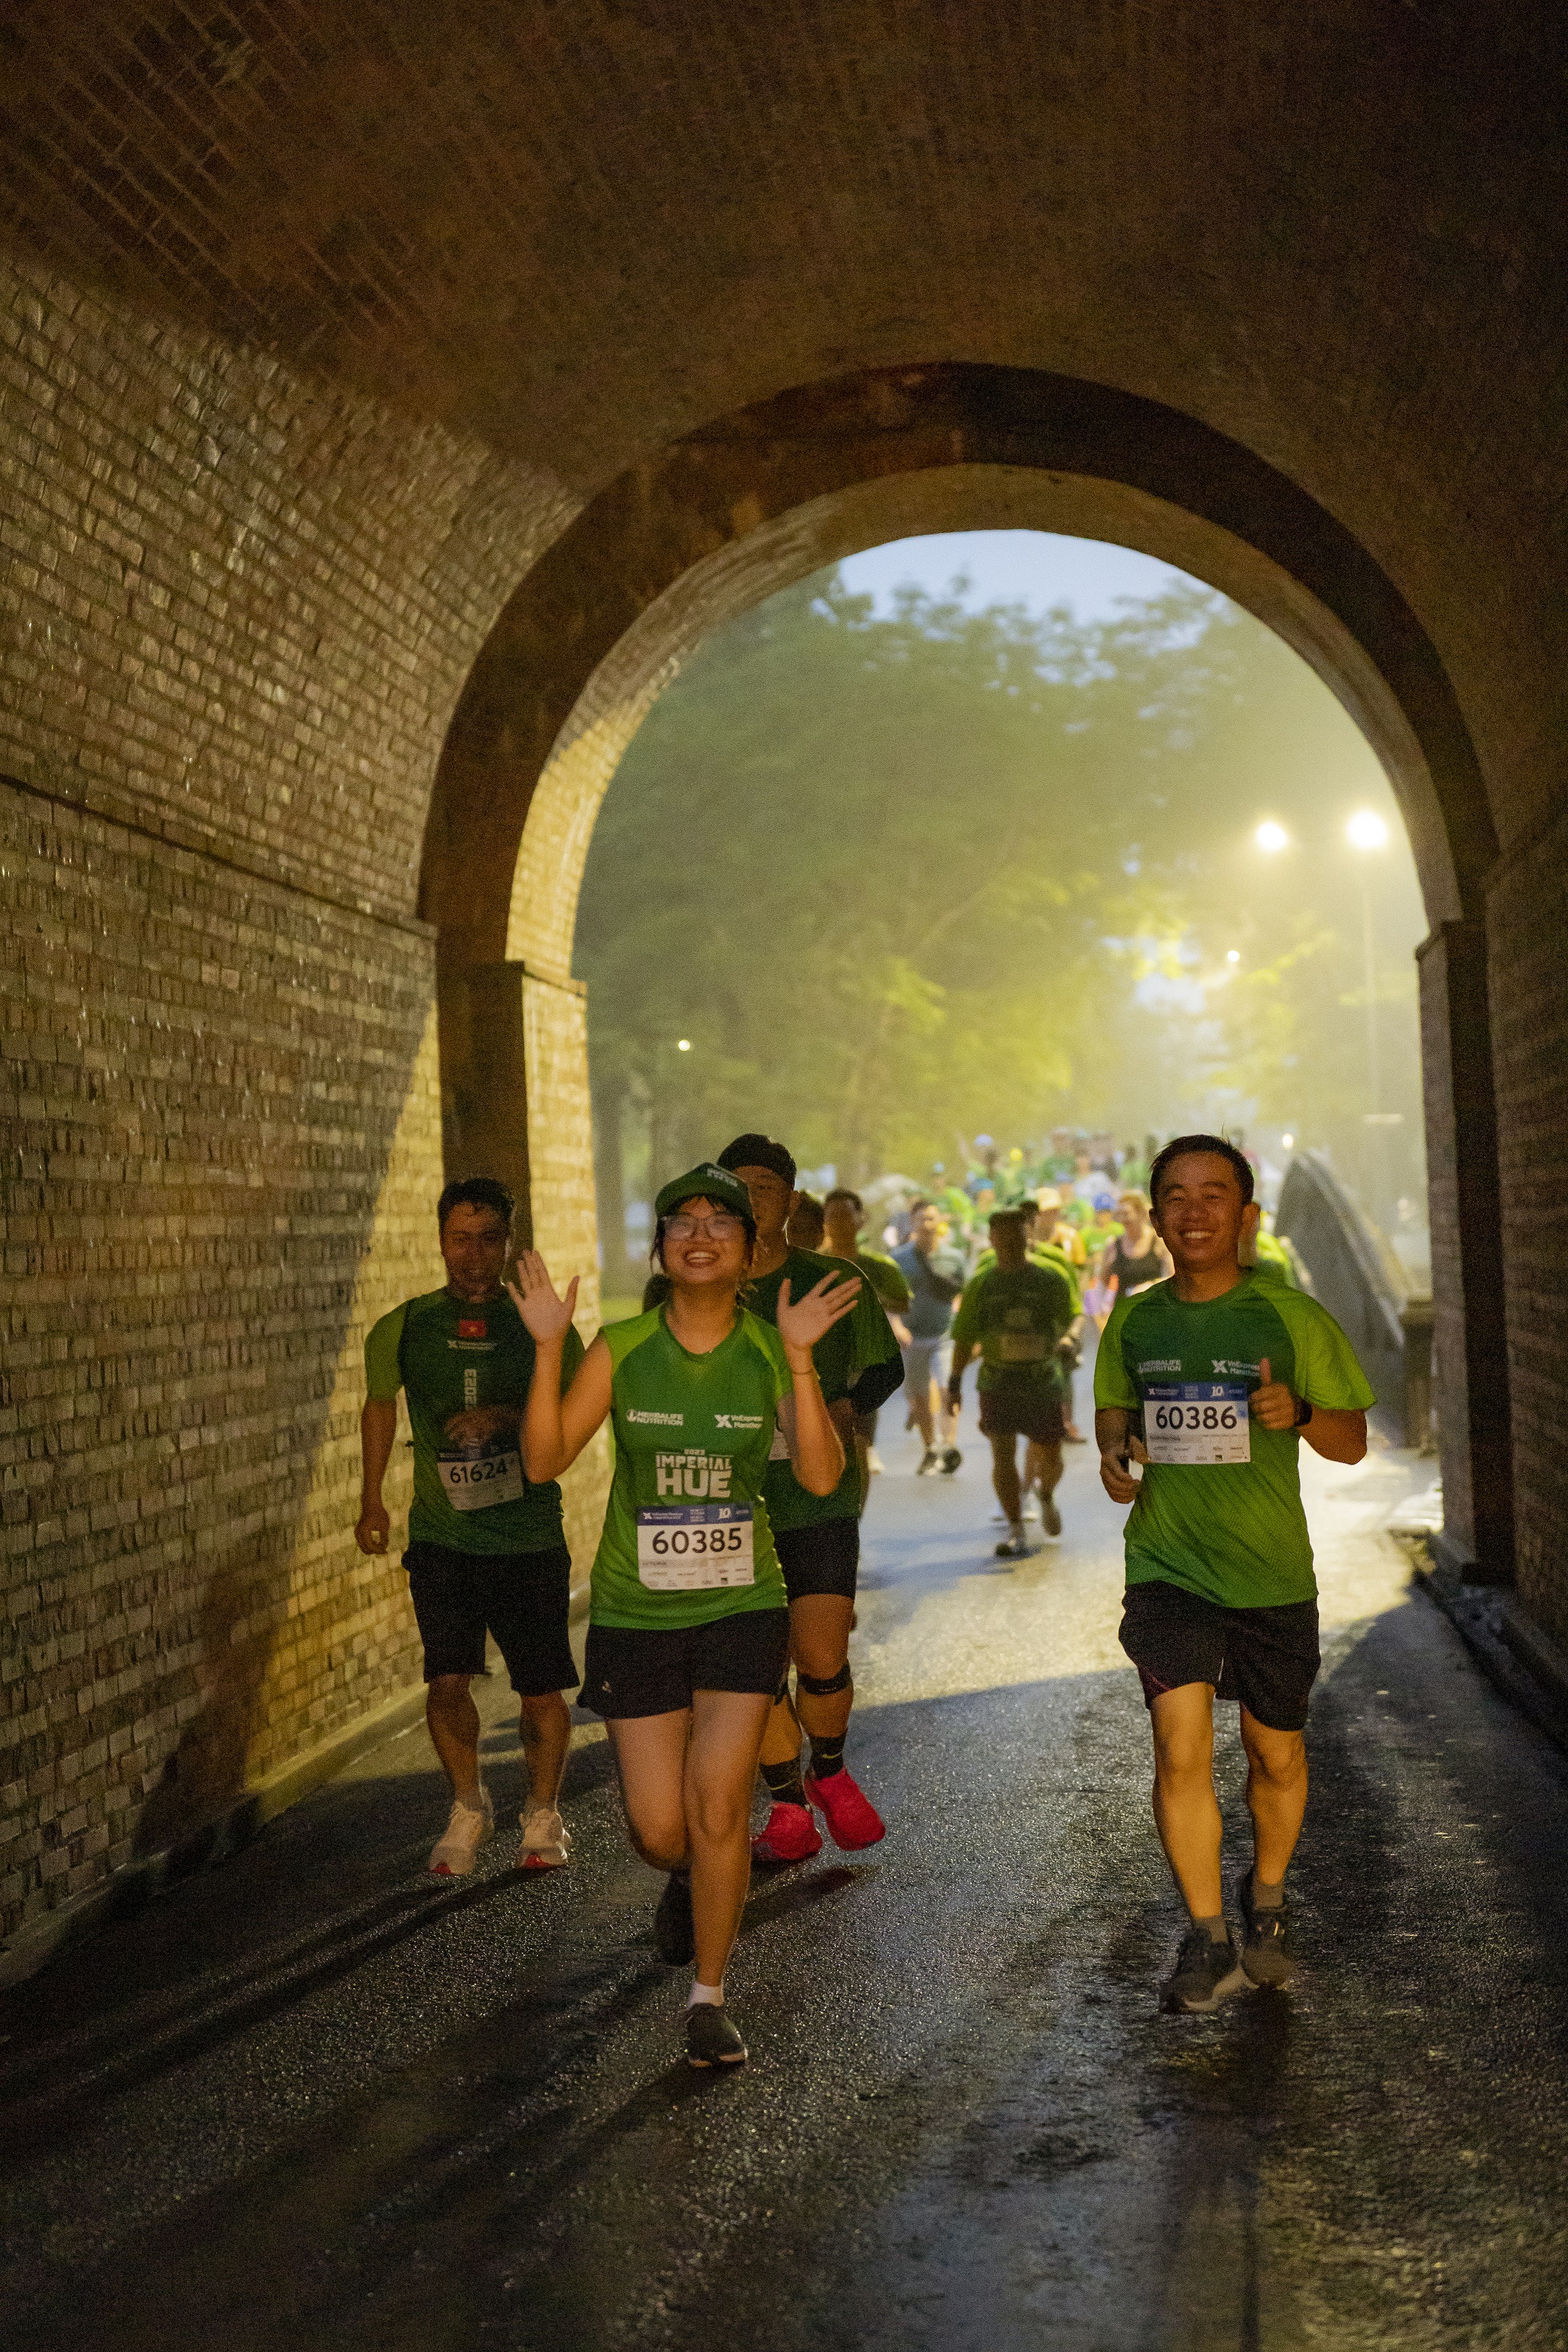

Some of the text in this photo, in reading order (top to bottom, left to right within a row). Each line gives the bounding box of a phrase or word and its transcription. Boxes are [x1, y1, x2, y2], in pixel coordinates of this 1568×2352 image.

[637, 1417, 684, 1426] NUTRITION
[1156, 1405, 1237, 1429] 60386
[449, 1457, 508, 1484] 61624
[656, 1455, 733, 1470] IMPERIAL
[657, 1468, 733, 1498] HUE
[652, 1527, 742, 1555] 60385
